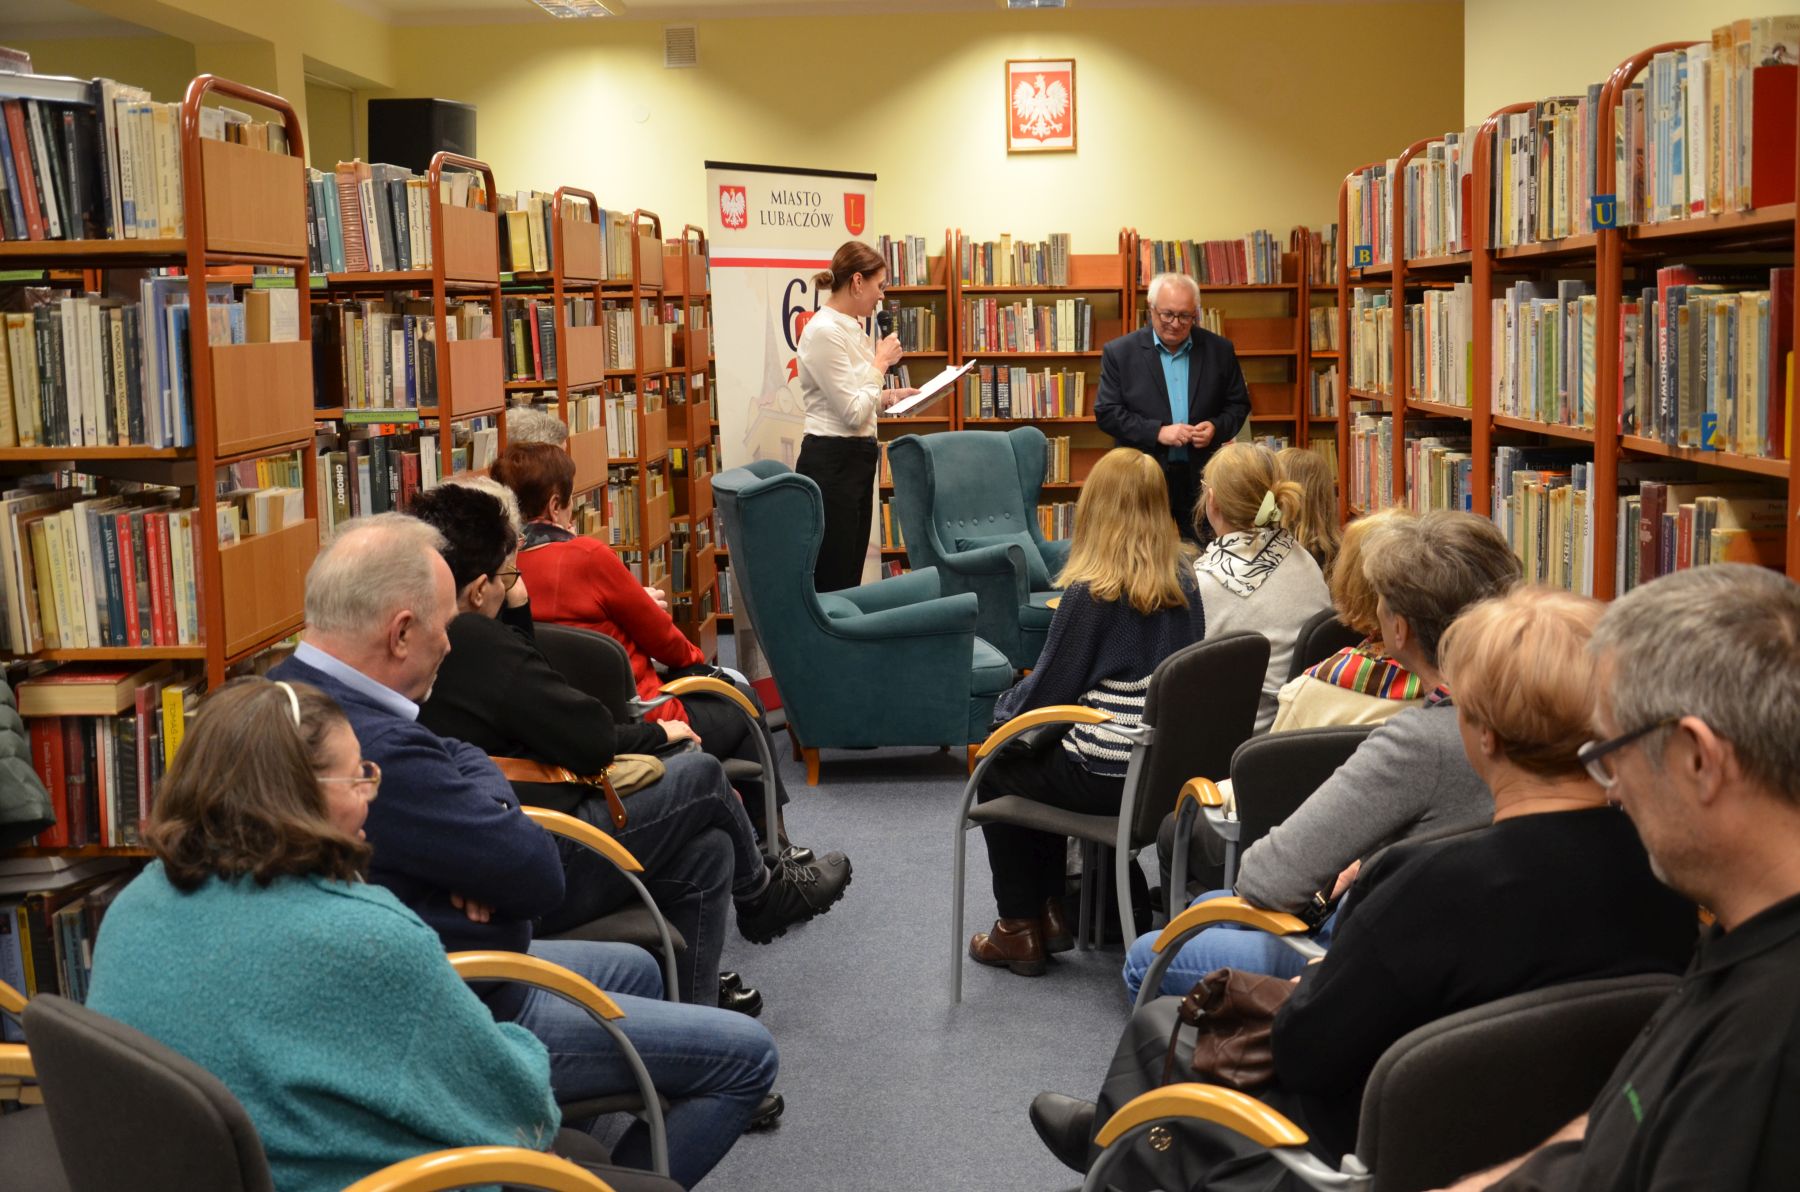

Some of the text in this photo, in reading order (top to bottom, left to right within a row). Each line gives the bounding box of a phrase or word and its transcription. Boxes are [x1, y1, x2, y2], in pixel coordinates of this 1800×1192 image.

[771, 190, 822, 207] MIASTO
[760, 209, 834, 228] LUBACZÓW
[1595, 203, 1614, 225] U
[1359, 249, 1371, 263] B
[335, 464, 345, 505] CHROBOT
[104, 528, 112, 542] JAN
